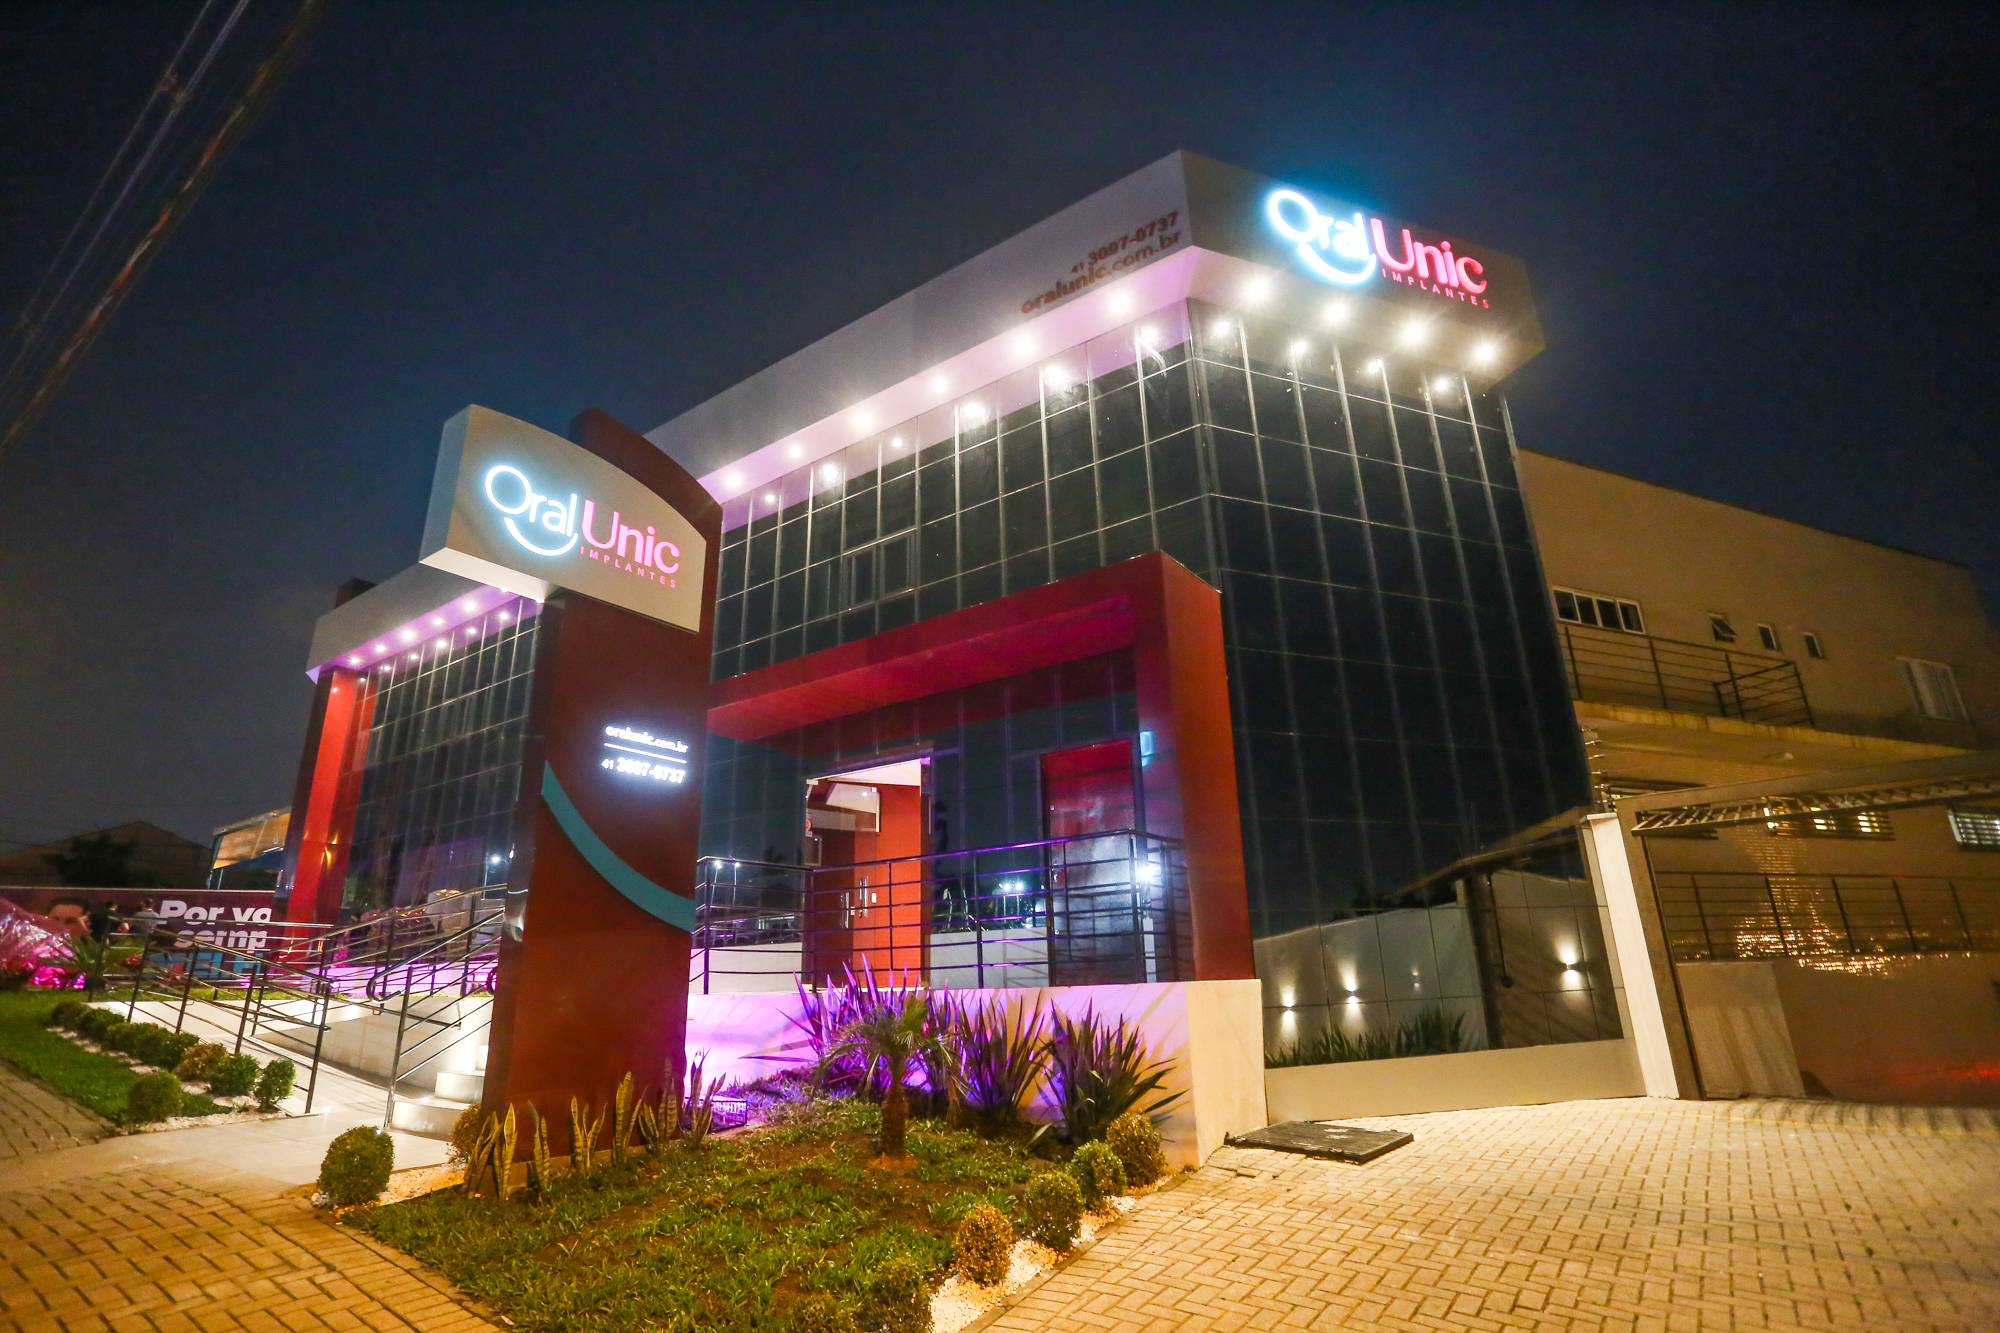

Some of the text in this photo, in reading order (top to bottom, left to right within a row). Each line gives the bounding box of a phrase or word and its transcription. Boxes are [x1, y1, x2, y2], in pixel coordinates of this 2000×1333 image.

[1268, 189, 1488, 294] Oral Unic
[1021, 230, 1182, 314] oralunic.com.br
[1382, 268, 1490, 309] IMPLANTES
[485, 464, 681, 574] Oral Unic
[580, 545, 677, 589] IMPLANTES
[604, 725, 689, 753] oralunic.com.br
[601, 758, 615, 770] 41
[157, 899, 226, 926] Por
